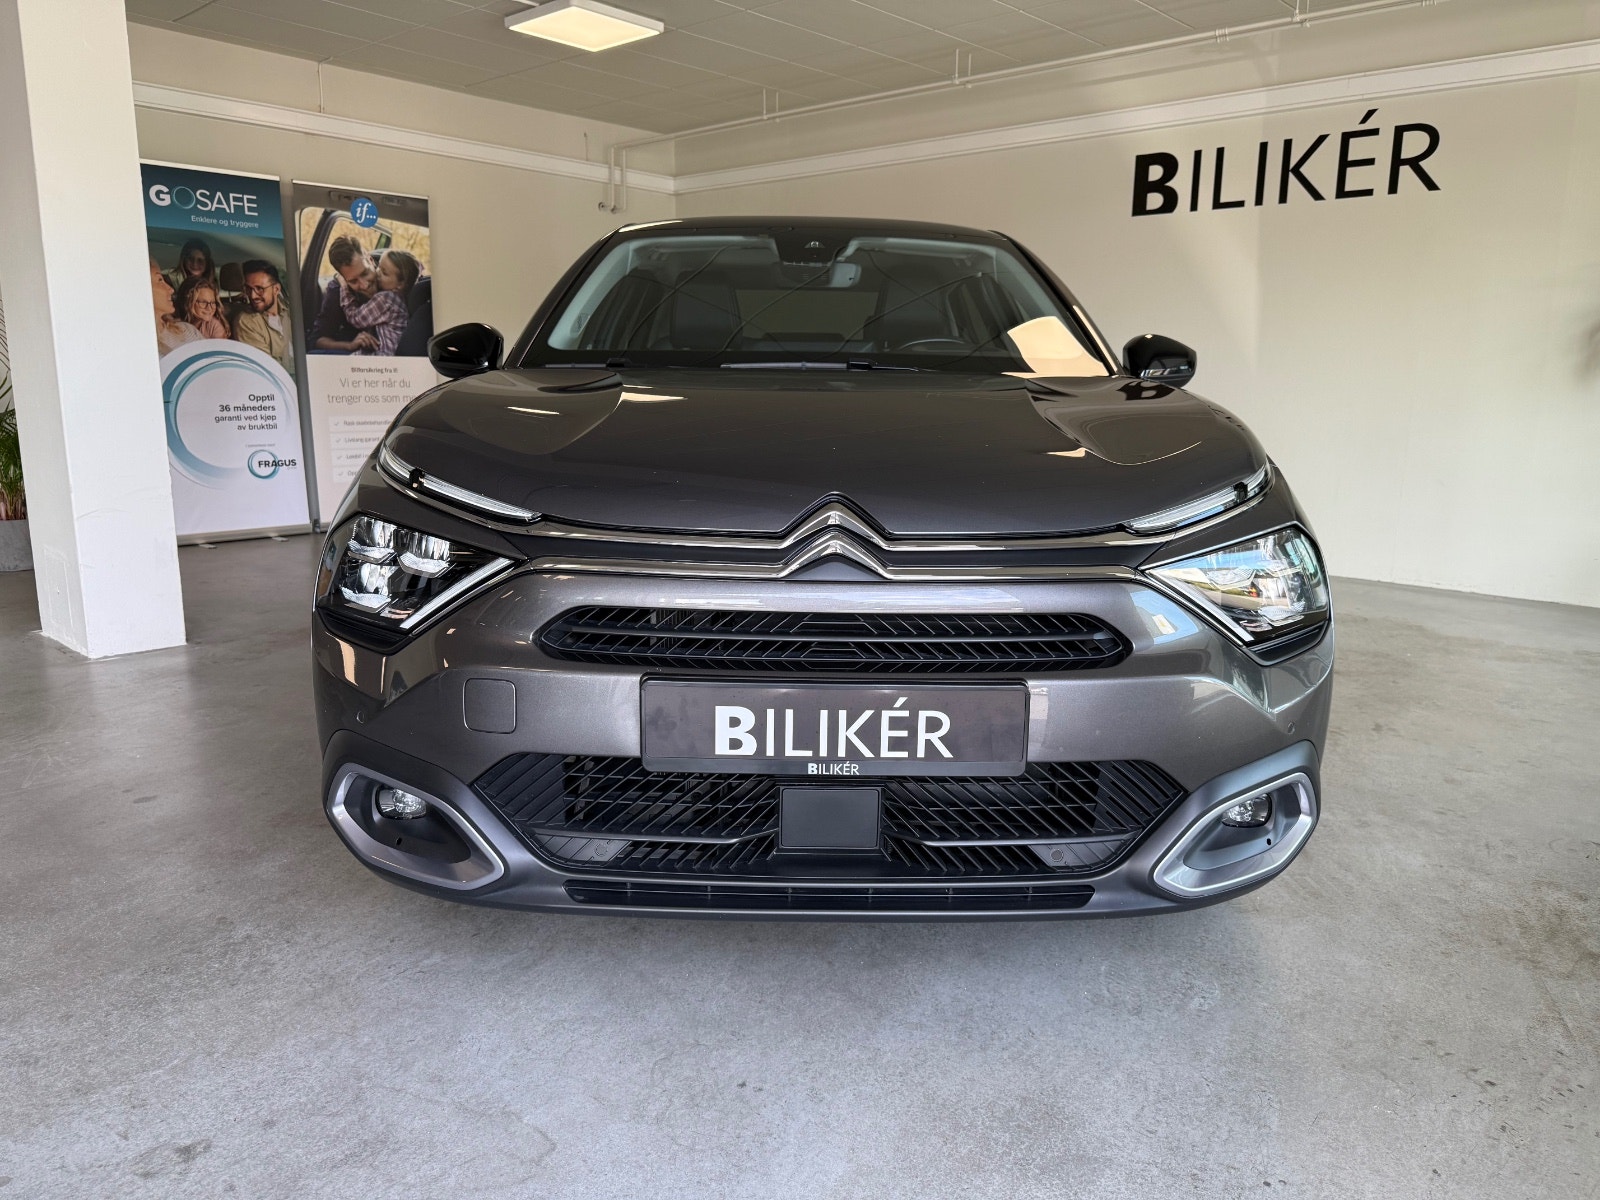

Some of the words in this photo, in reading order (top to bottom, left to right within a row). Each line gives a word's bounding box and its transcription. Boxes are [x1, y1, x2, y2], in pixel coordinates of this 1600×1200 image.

[1131, 108, 1441, 217] BILIKÉR
[149, 184, 258, 216] GOSAFE
[191, 215, 218, 224] Enklere
[230, 220, 259, 228] tryggere
[340, 377, 349, 388] Vi
[352, 380, 361, 388] er
[364, 378, 380, 388] her
[382, 377, 397, 388] når
[400, 378, 411, 388] du
[248, 394, 275, 402] Opptil
[327, 394, 362, 405] trenger
[365, 395, 380, 403] oss
[381, 395, 400, 403] som
[219, 404, 231, 412] 36
[233, 404, 276, 412] måneders
[214, 414, 242, 423] garanti
[260, 413, 277, 422] kjøp
[258, 459, 297, 468] FRAGUS
[714, 697, 954, 758] BILIKÉR
[807, 761, 860, 776] BILIKÉR
